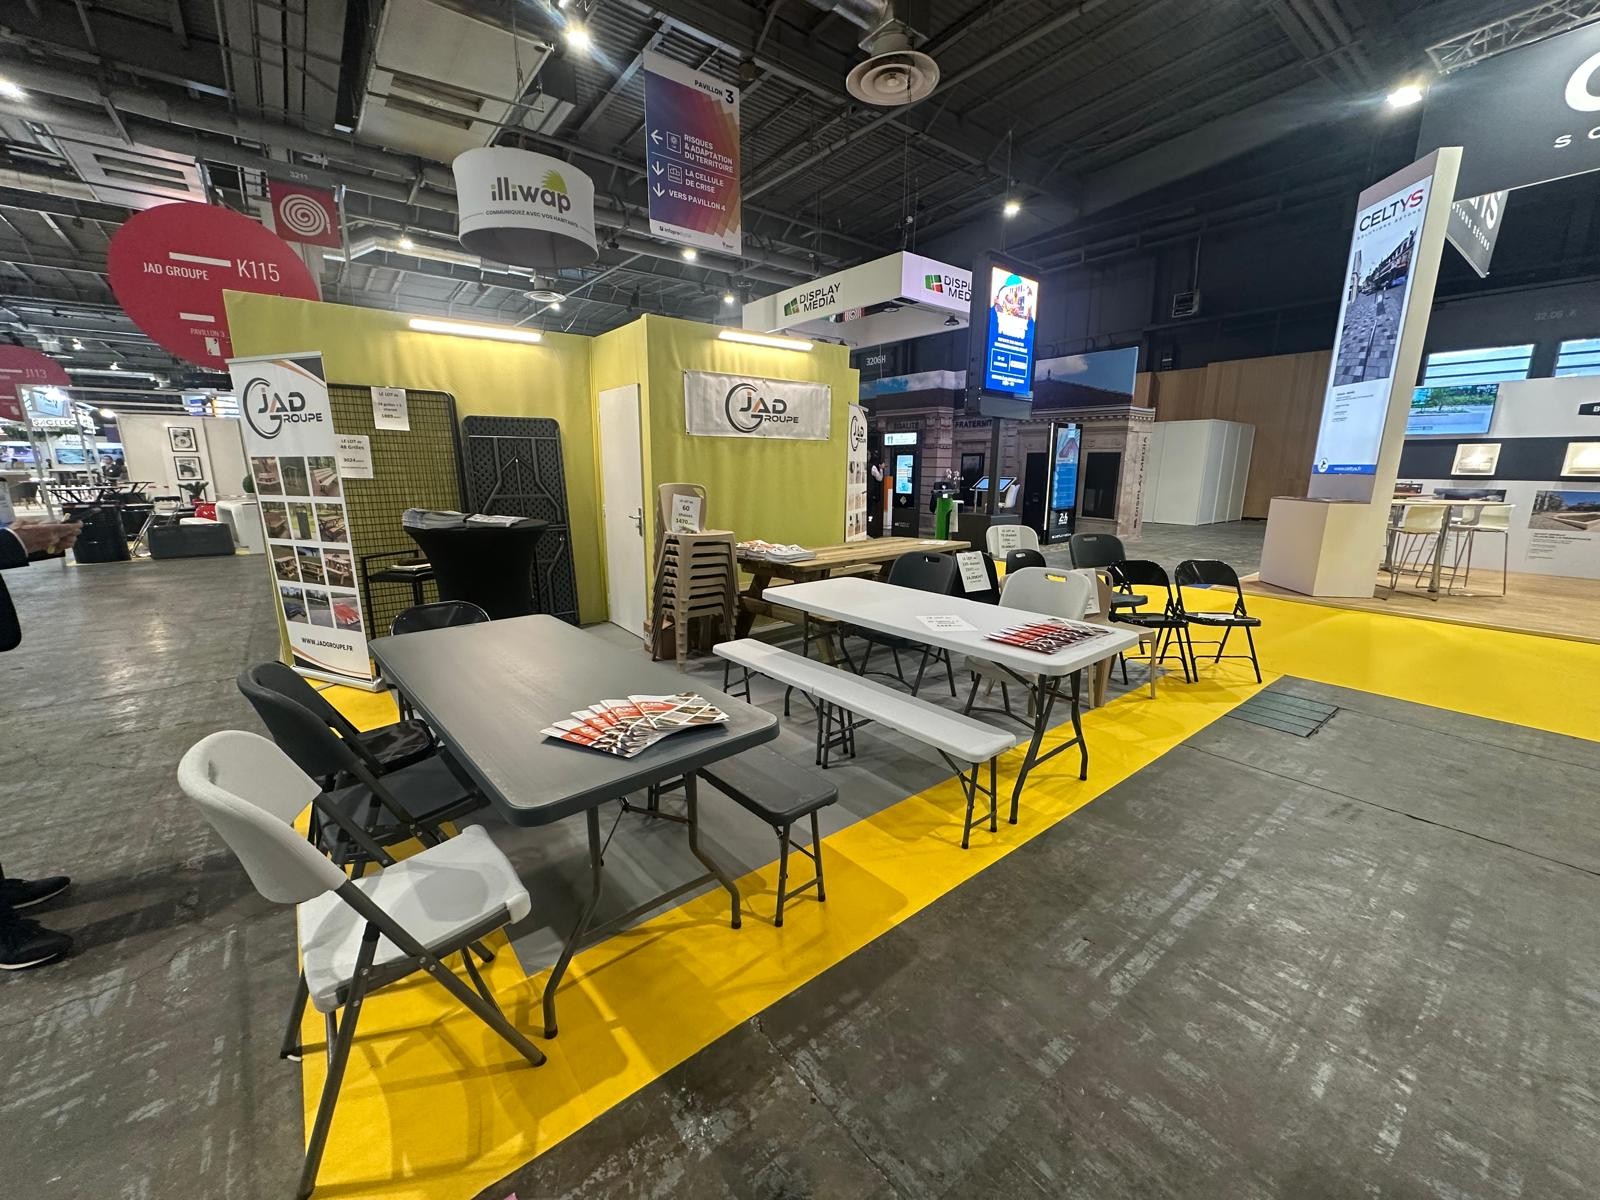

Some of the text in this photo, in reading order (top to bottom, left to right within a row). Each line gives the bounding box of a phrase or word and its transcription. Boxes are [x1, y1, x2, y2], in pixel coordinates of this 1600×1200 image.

[694, 80, 734, 104] PAVILLON 3
[684, 134, 714, 150] RISQUES
[684, 151, 734, 173] DU TERRITOIRE
[690, 145, 733, 166] ADAPTATION
[685, 168, 724, 187] LA CELLULE
[686, 179, 716, 194] DE CRISE
[490, 176, 572, 214] illiwap
[669, 189, 687, 200] VERS
[688, 194, 720, 210] PAVILLON
[1359, 188, 1424, 232] CELTYS
[554, 216, 579, 228] HABITANTS
[143, 262, 209, 281] JAD GROUPE
[237, 259, 280, 282] K115
[799, 282, 841, 304] DISPLAY
[944, 275, 972, 292] DISPL
[803, 295, 836, 313] MEDIA
[948, 287, 972, 302] MED
[258, 387, 306, 414] JAD
[738, 391, 788, 414] JAD
[954, 418, 992, 429] FRATERNIT
[301, 636, 353, 652] WWW.JADGROUPE.FR
